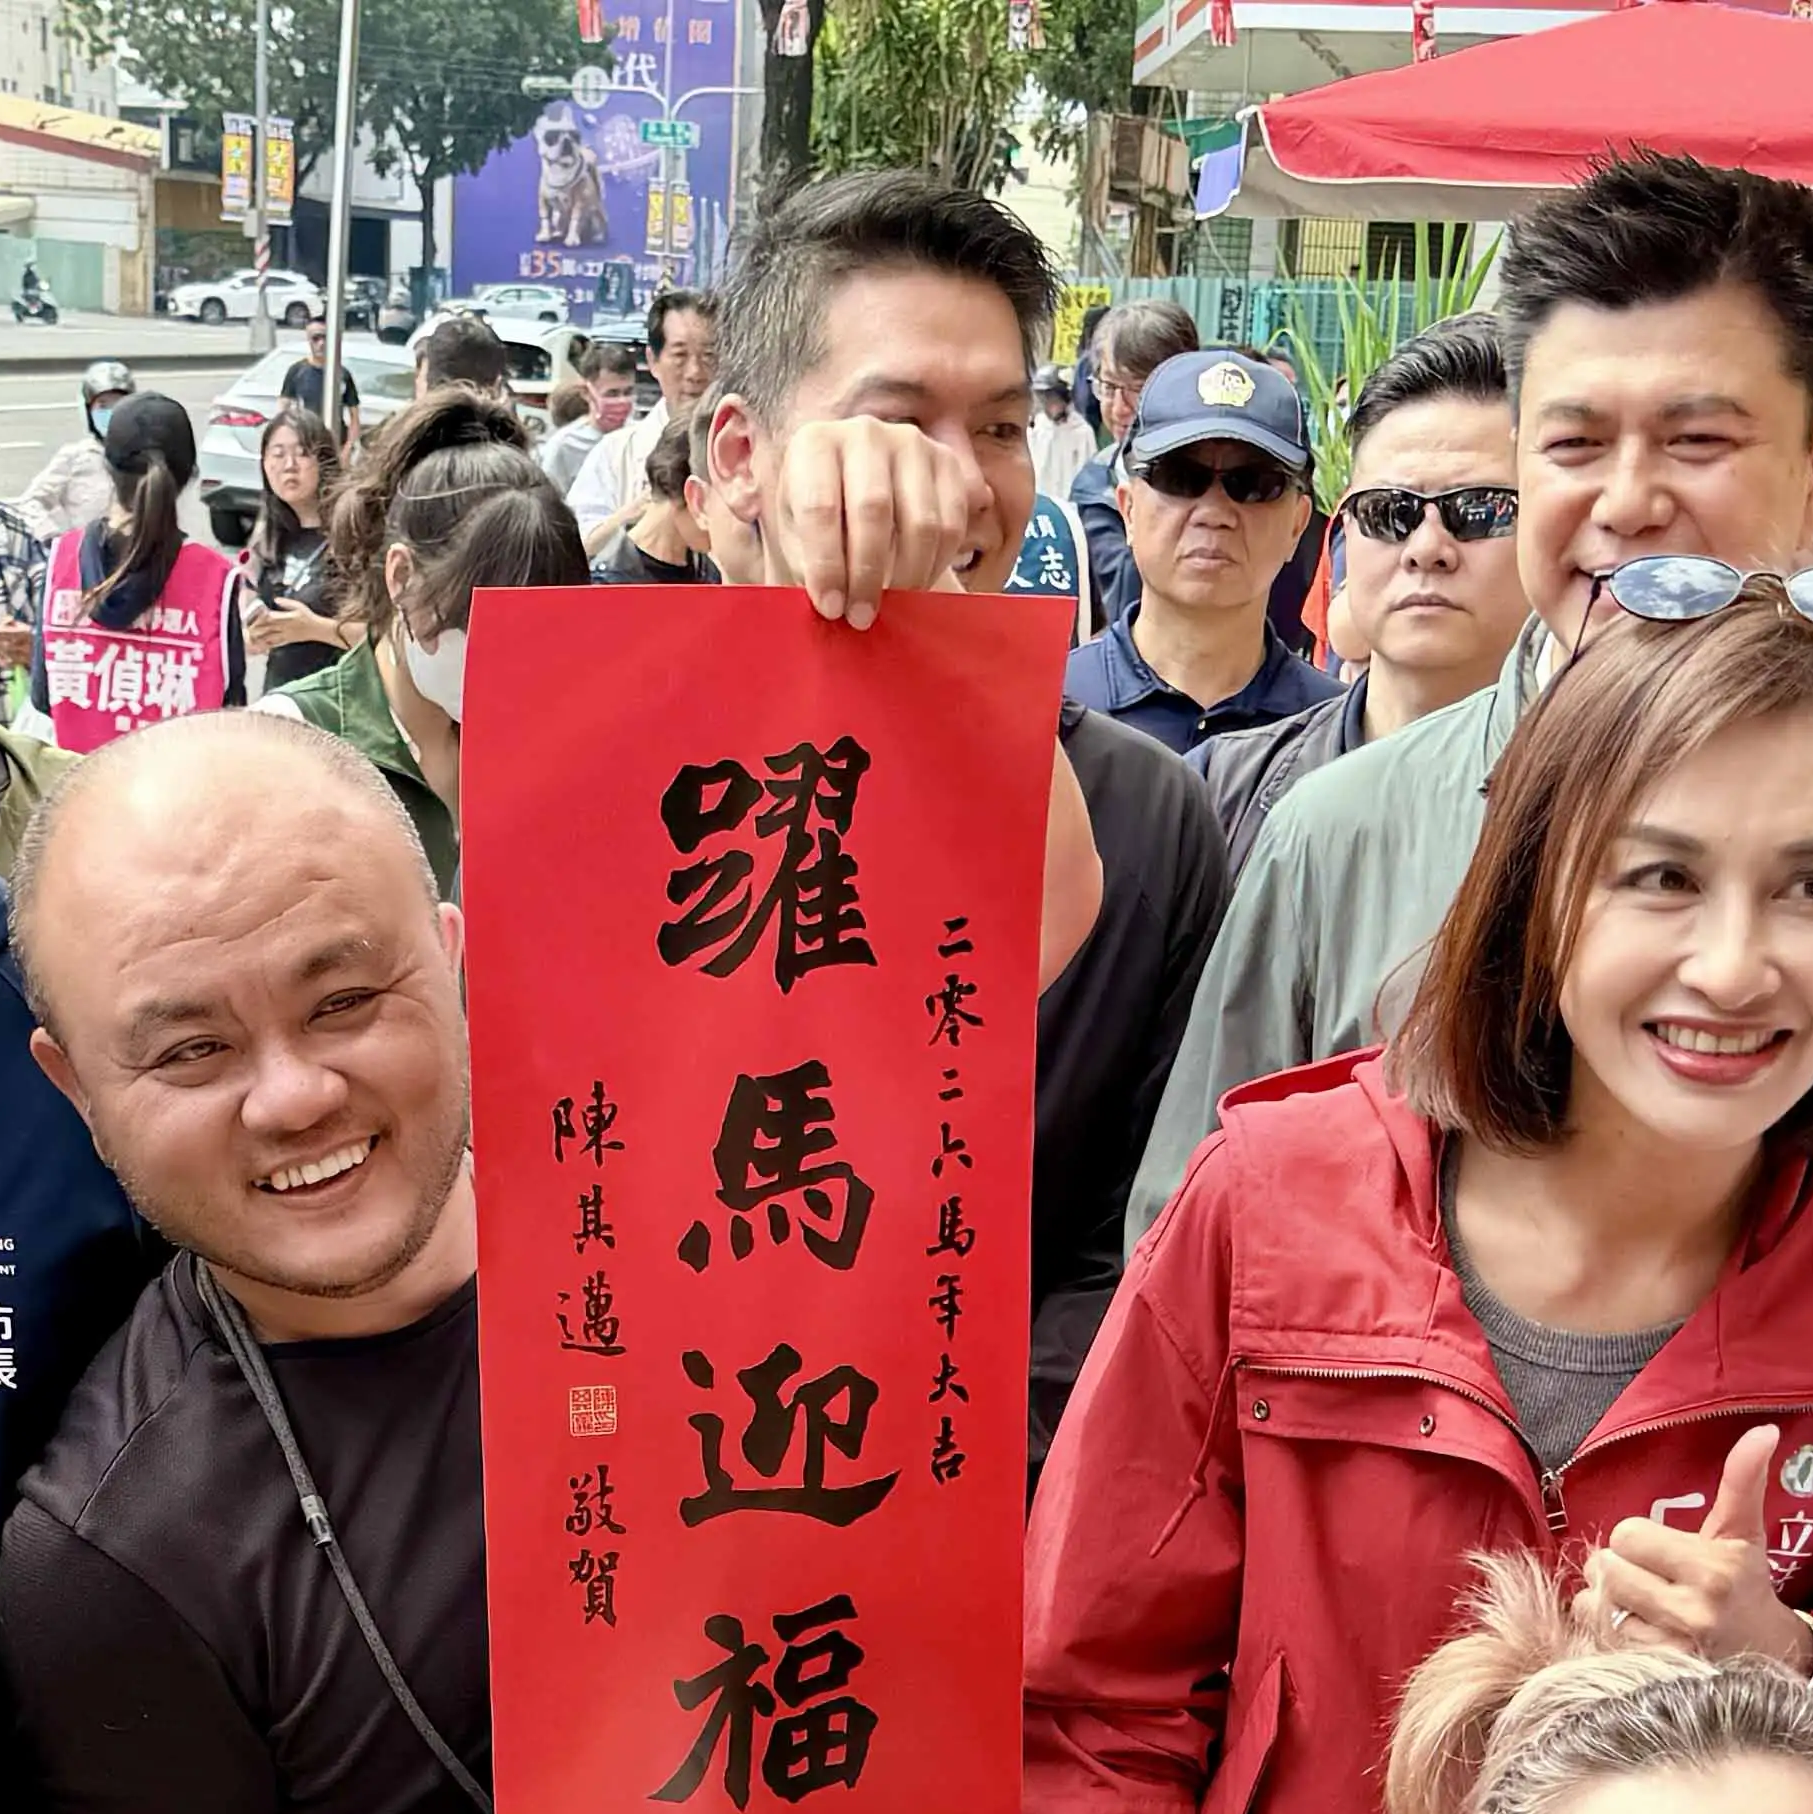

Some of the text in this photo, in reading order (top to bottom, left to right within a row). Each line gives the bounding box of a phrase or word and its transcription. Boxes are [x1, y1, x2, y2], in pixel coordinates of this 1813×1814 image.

[552, 1080, 627, 1357] 陳其邁
[648, 735, 903, 1811] 躍馬迎福
[924, 916, 984, 1486] 二零二六馬年大吉
[564, 1464, 627, 1627] 敬賀
